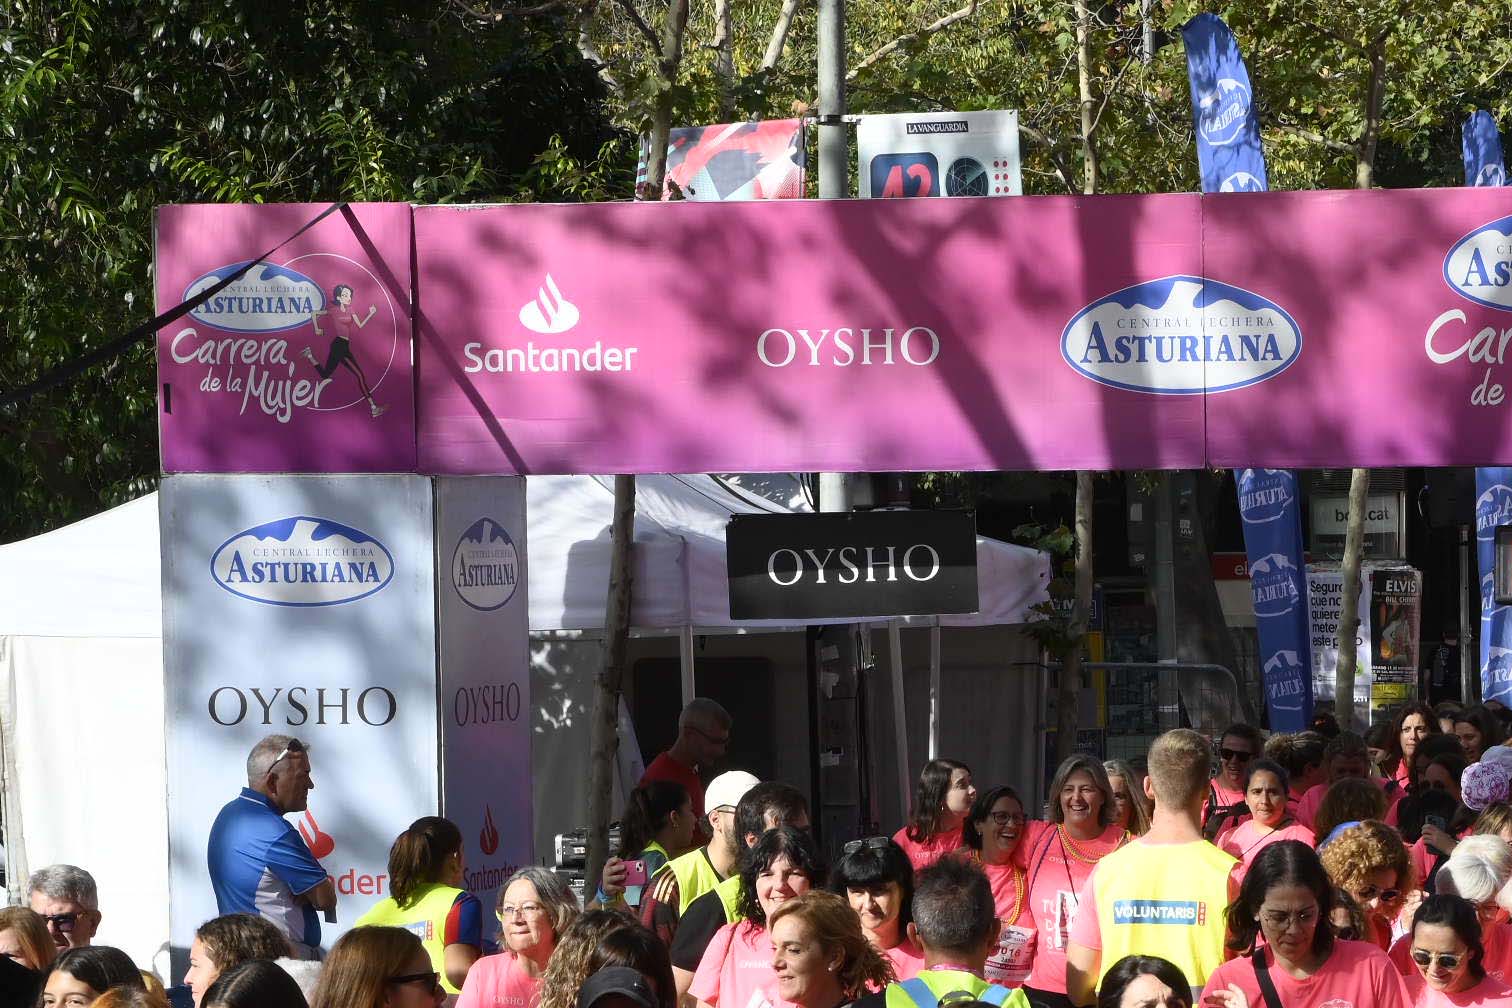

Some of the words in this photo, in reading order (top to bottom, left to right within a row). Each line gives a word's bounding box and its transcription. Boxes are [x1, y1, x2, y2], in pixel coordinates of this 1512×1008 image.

[1117, 317, 1191, 329] CENTRAL
[1201, 316, 1275, 328] LECHERA
[171, 328, 289, 364] Carrera
[464, 341, 638, 374] Santander
[757, 326, 940, 367] OYSHO
[1080, 321, 1284, 364] ASTURIANA
[200, 363, 222, 392] de
[227, 369, 242, 392] la
[240, 361, 333, 423] Mujer
[1470, 367, 1505, 407] de
[225, 550, 381, 583] ASTURIANA
[253, 549, 311, 557] CENTRAL
[316, 549, 375, 557] LECHERA
[768, 544, 940, 588] OYSHO
[458, 554, 516, 587] ASTURIANA
[1385, 580, 1416, 592] ELVIS
[1313, 637, 1331, 647] este
[208, 686, 397, 727] OYSHO
[454, 682, 521, 727] OYSHO
[1114, 905, 1196, 920] VOLUNTARIS
